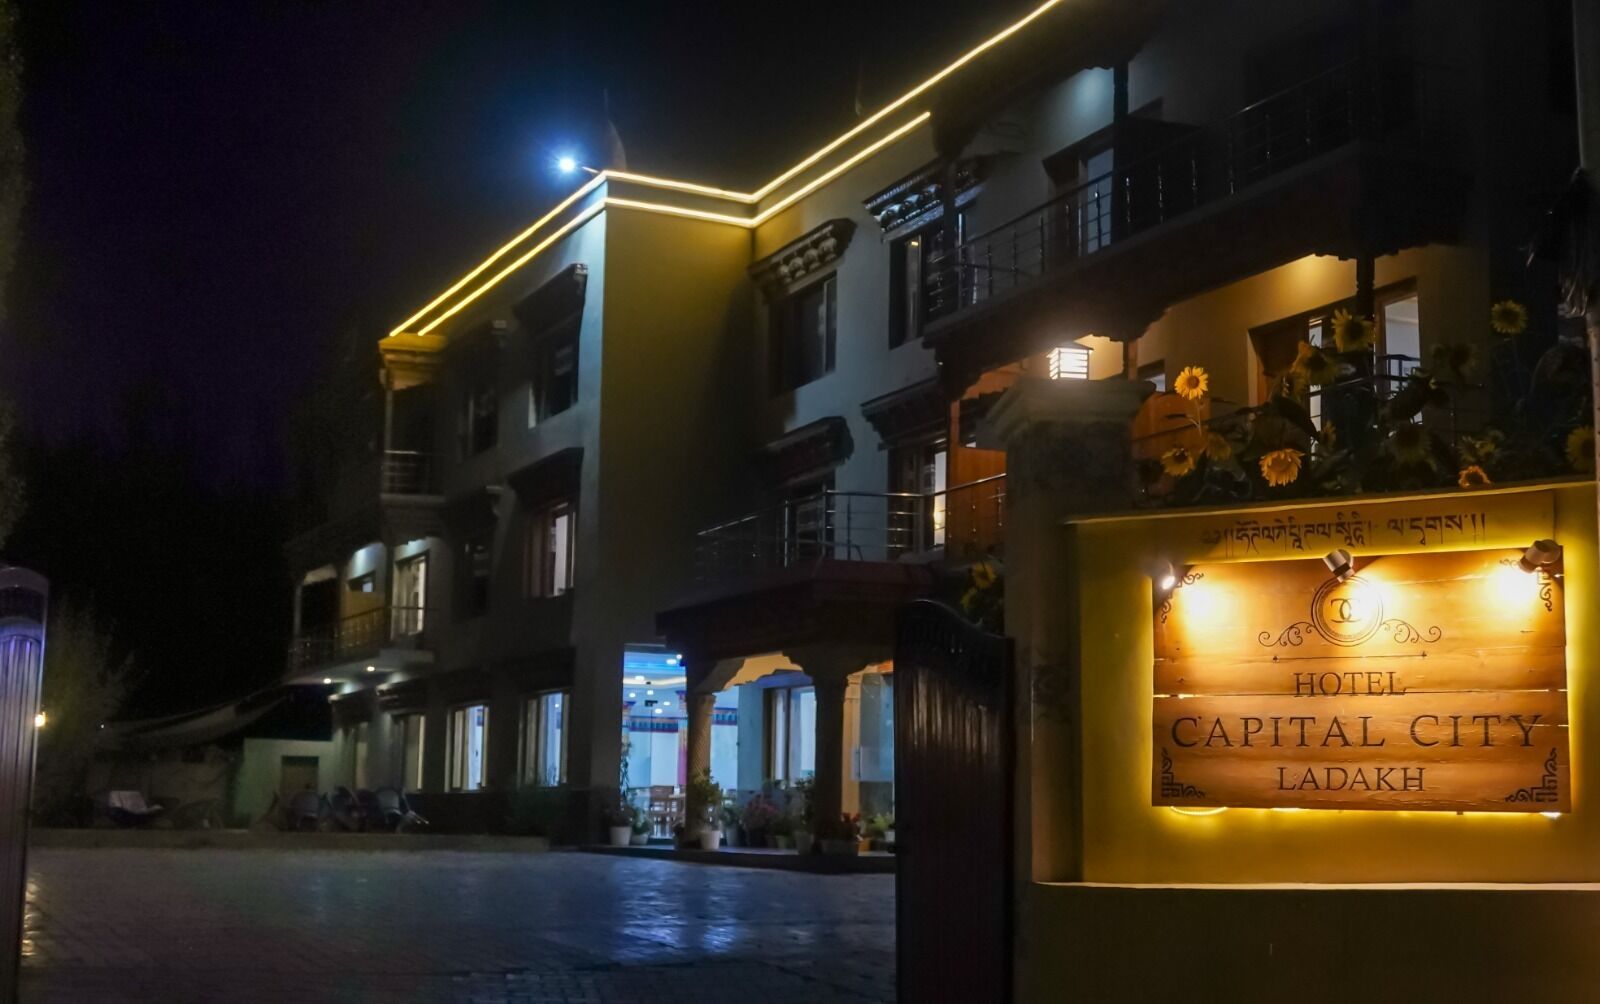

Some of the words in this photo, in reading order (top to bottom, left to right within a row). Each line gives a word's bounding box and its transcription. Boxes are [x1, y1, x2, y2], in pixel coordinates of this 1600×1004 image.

[1294, 671, 1406, 697] HOTEL
[1171, 716, 1385, 748] CAPITAL
[1410, 714, 1542, 747] CITY
[1277, 767, 1426, 792] LADAKH
